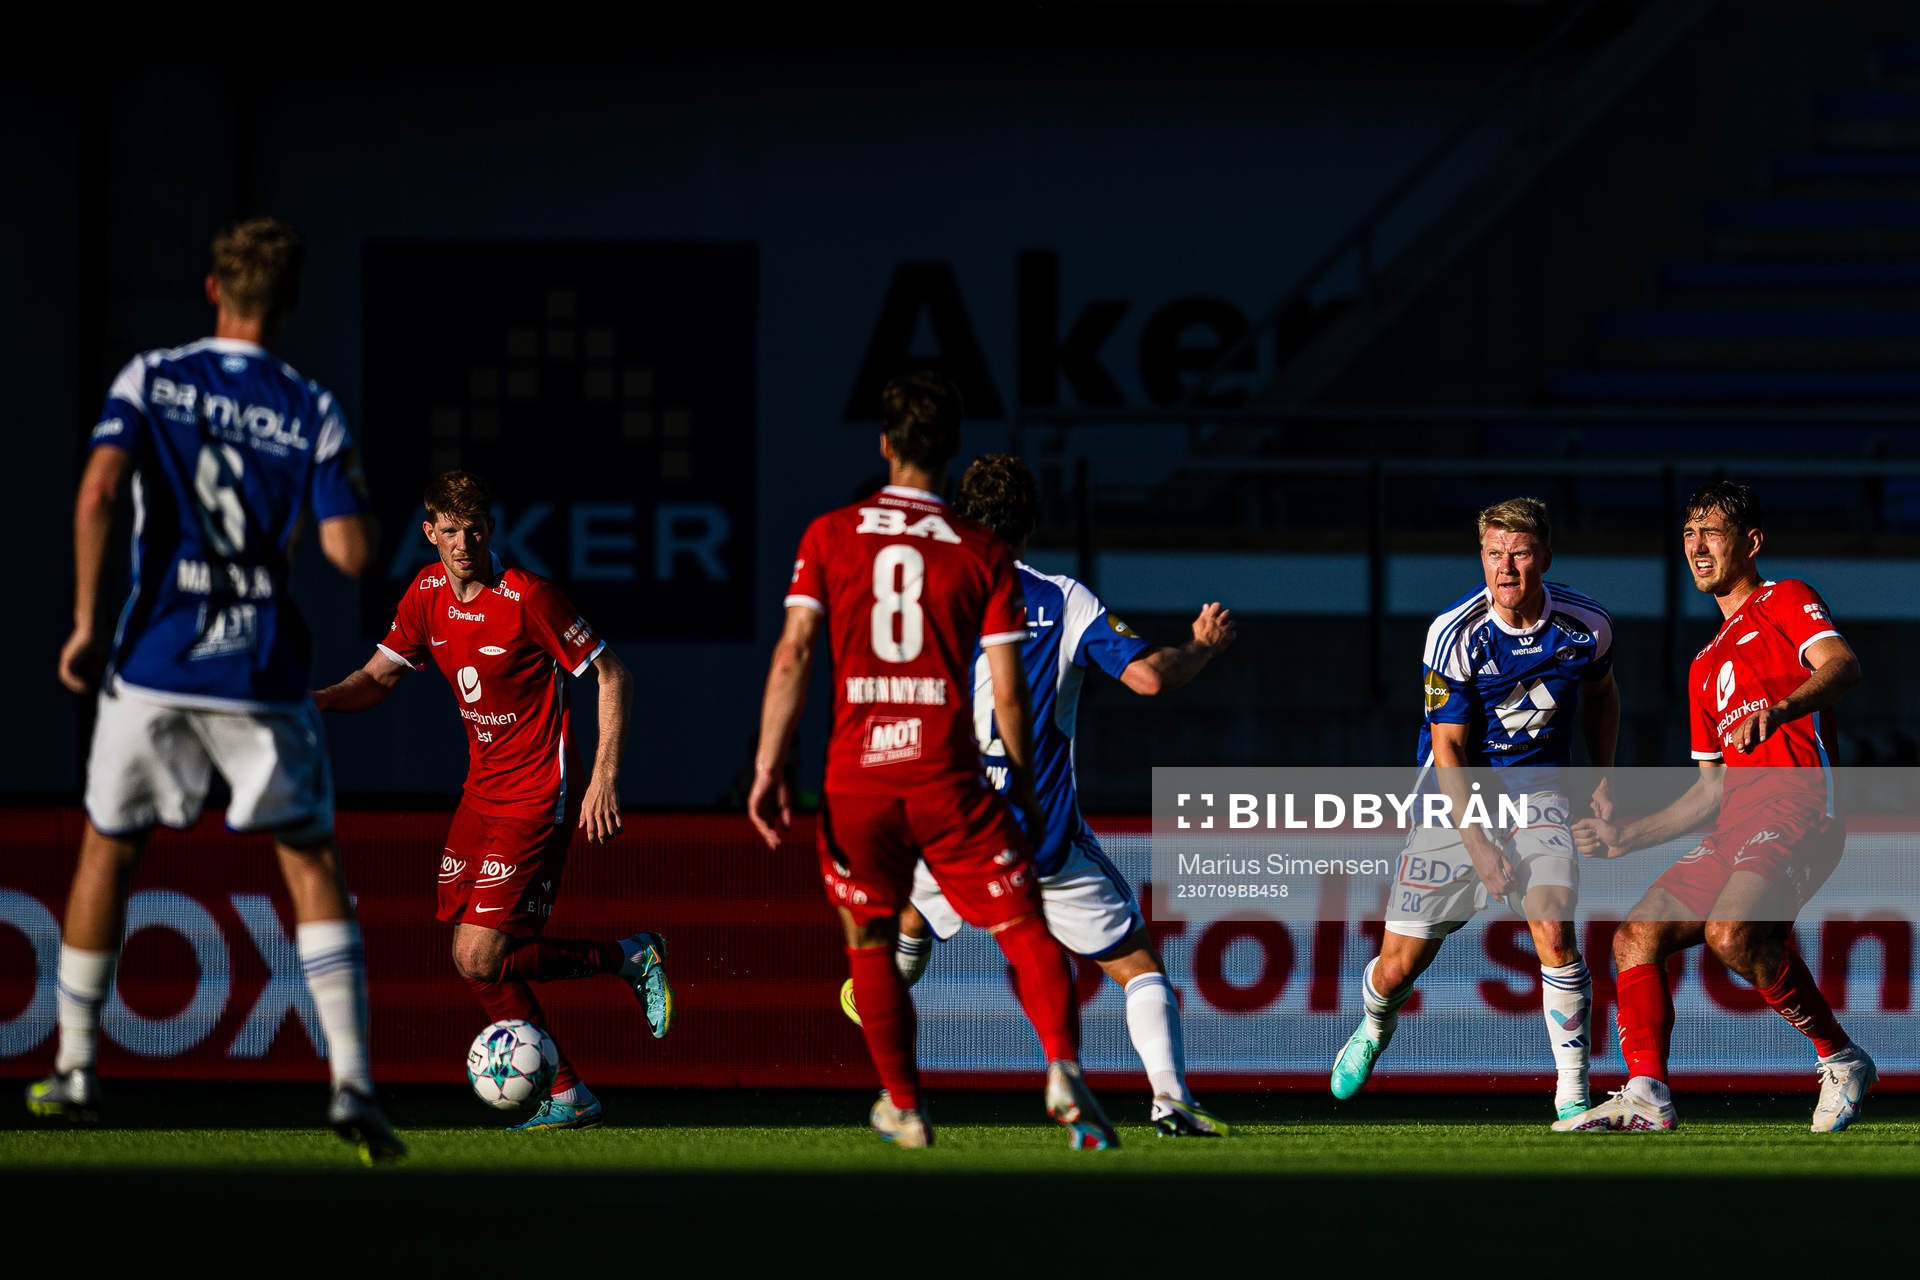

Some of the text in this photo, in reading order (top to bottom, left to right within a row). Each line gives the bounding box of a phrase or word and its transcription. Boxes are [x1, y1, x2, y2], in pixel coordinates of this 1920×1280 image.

[842, 250, 1362, 419] Aker
[856, 506, 962, 545] BA
[503, 588, 521, 602] BOB
[870, 543, 925, 664] 8
[455, 610, 485, 622] Fjordkraft
[1511, 645, 1543, 656] wenaas
[871, 718, 922, 751] MOT
[1401, 891, 1422, 913] 20
